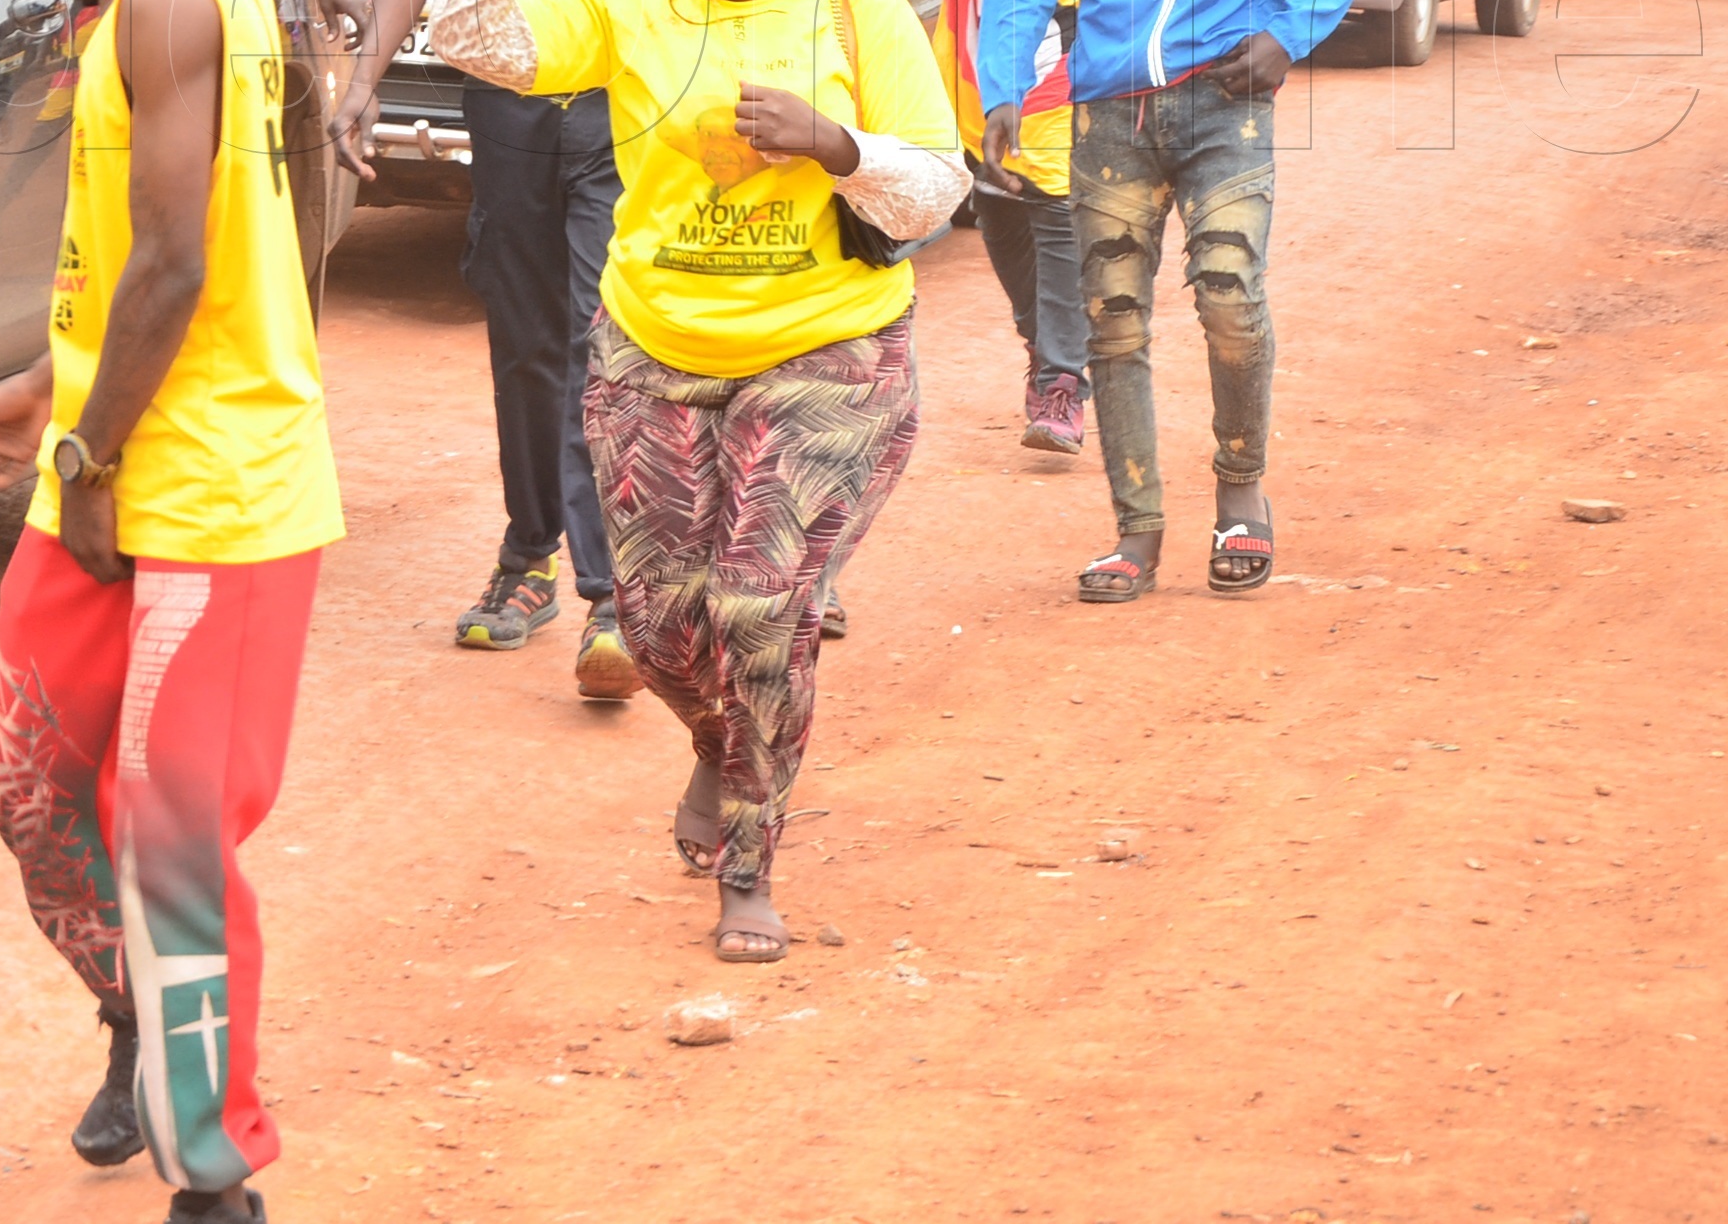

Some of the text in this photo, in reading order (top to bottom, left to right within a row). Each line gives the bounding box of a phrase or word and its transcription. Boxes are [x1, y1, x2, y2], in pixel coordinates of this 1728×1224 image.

[695, 200, 795, 226] YOWRI
[678, 223, 808, 247] MUSEVENI
[668, 250, 743, 267] PROTECTING
[746, 254, 770, 267] THE
[1226, 536, 1272, 555] PUMA
